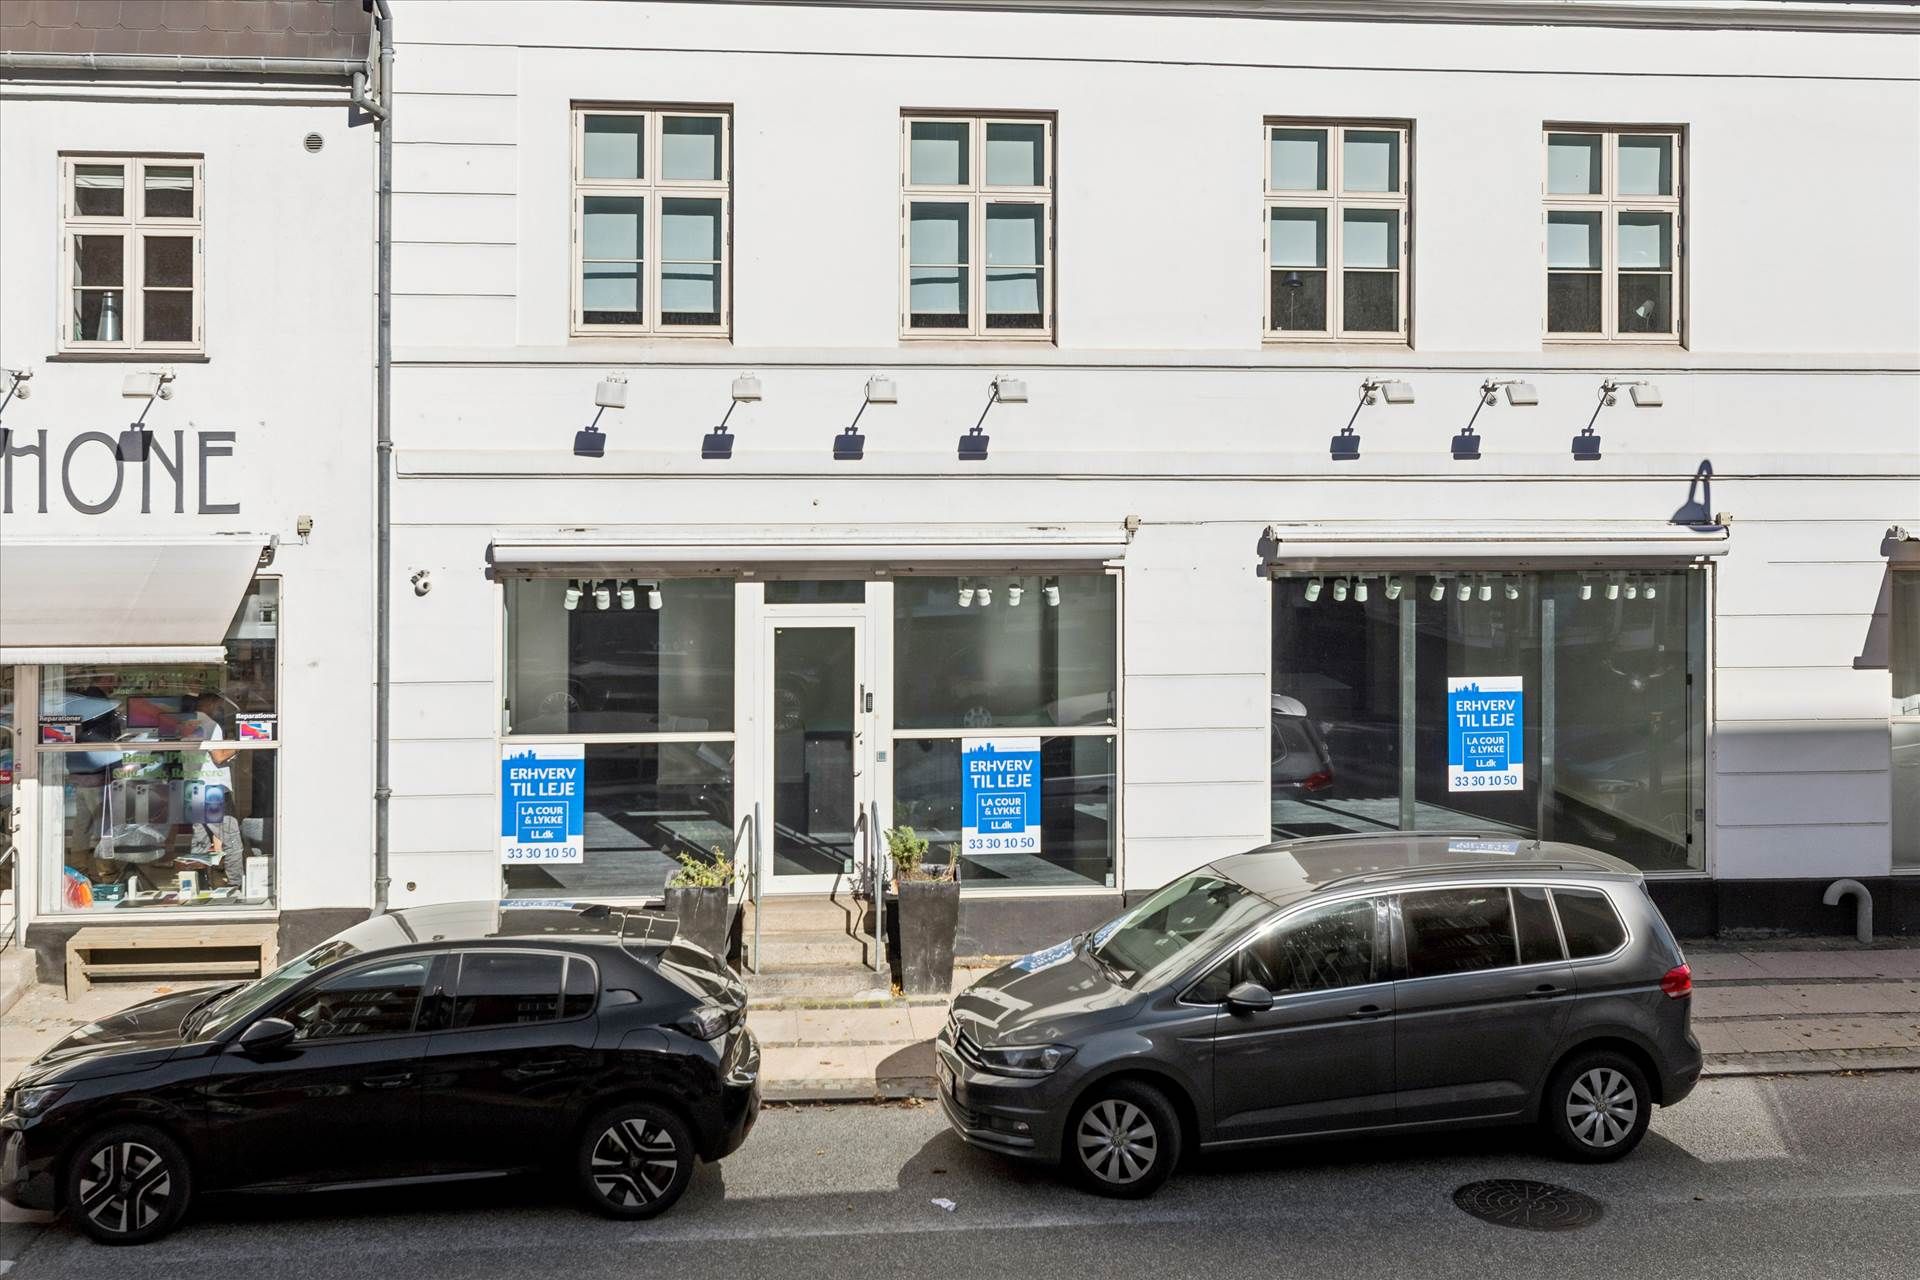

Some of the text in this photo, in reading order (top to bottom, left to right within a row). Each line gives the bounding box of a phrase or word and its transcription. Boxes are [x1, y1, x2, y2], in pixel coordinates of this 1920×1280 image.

[1456, 700, 1516, 712] ERHVERV
[1456, 714, 1514, 728] TIL LEJE
[1466, 736, 1504, 745] LA COUR
[970, 760, 1033, 773] ERHVERV
[510, 768, 576, 780] ERHVERV
[970, 774, 1032, 789] TIL LEJE
[1455, 775, 1517, 786] 33 30 10 50
[510, 782, 576, 797] TIL LEJE
[981, 798, 1021, 807] LA COUR
[521, 807, 564, 815] LA COUR
[984, 807, 1021, 816] & LYKKE
[524, 816, 564, 824] & LYKKE
[969, 838, 1034, 850] 33 30 10 50
[507, 848, 576, 859] 33 30 10 50
